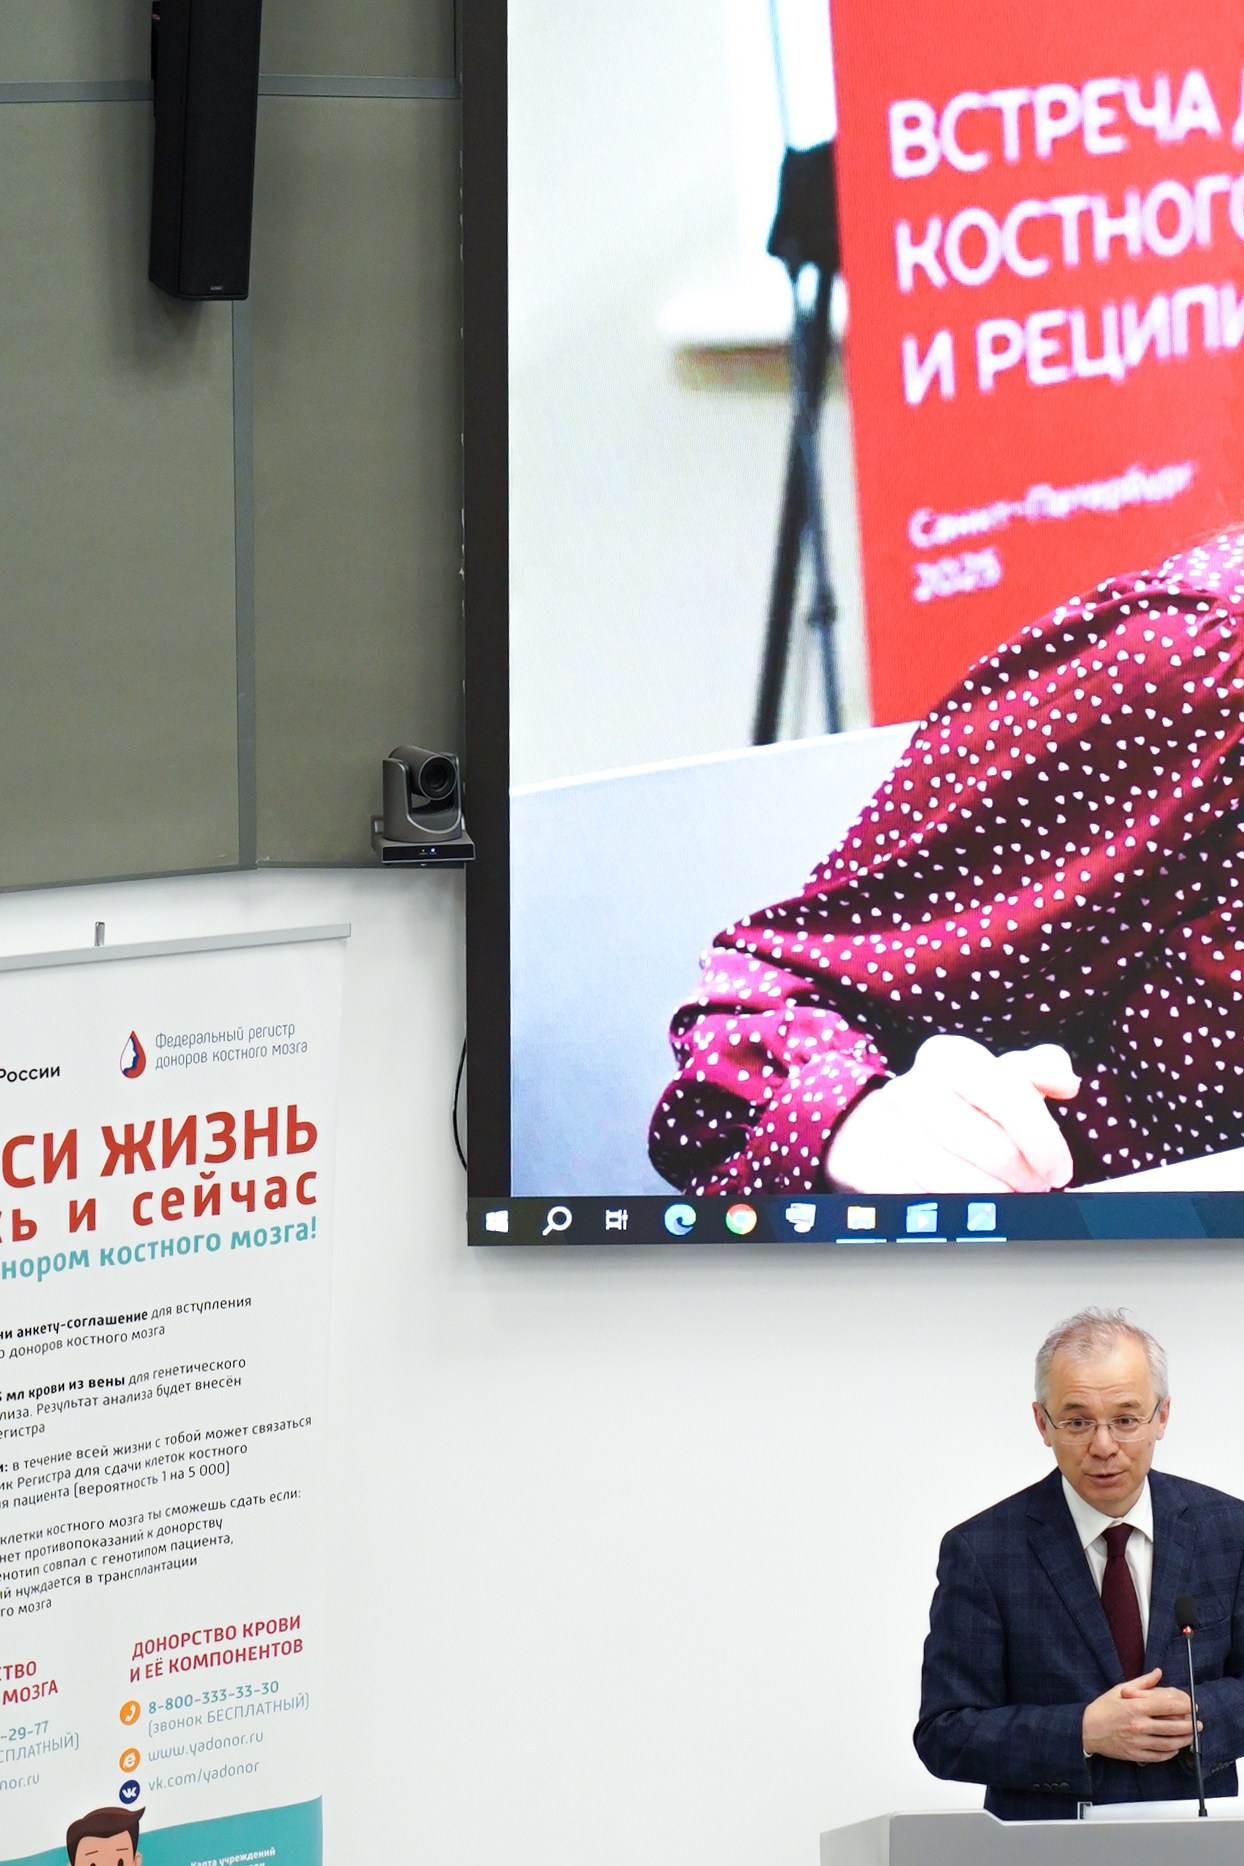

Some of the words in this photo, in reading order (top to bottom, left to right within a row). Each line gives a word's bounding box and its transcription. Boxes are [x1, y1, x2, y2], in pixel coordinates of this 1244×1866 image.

[888, 68, 1222, 179] ВСТРЕЧА
[902, 328, 955, 406] И
[155, 1026, 244, 1049] Федеральный
[249, 1023, 295, 1043] регистр
[155, 1052, 208, 1071] доноров
[212, 1046, 267, 1062] костного
[272, 1041, 308, 1056] мозга
[2, 1128, 77, 1188] СИ
[100, 1104, 318, 1177] ЖИЗНЬ
[69, 1198, 96, 1233] и
[133, 1170, 317, 1226] сейчас
[2, 1249, 90, 1282] нором
[100, 1233, 221, 1267] костного
[230, 1215, 317, 1249] мозга!
[17, 1310, 148, 1338] анкету-соглашение
[151, 1306, 172, 1320] для
[176, 1297, 252, 1315] вступления
[9, 1339, 63, 1359] доноров
[67, 1331, 128, 1347] костного
[131, 1325, 165, 1341] мозга
[6, 1390, 25, 1401] мл
[29, 1381, 65, 1399] крови
[69, 1380, 84, 1390] из
[88, 1375, 125, 1388] вены
[128, 1371, 149, 1385] для
[153, 1358, 246, 1380] генетического
[37, 1396, 98, 1415] Результат
[102, 1388, 153, 1406] анализа
[156, 1381, 192, 1398] будет
[195, 1375, 242, 1391] внесён
[12, 1461, 20, 1471] в
[24, 1450, 72, 1469] течение
[76, 1445, 109, 1459] всей
[112, 1441, 152, 1456] жизни
[155, 1438, 161, 1448] с
[164, 1430, 201, 1446] тобой
[205, 1426, 248, 1440] может
[252, 1416, 312, 1435] связаться
[13, 1486, 70, 1507] пациента
[74, 1474, 158, 1499] (вероятность
[162, 1470, 167, 1482] 1
[170, 1469, 184, 1480] на
[188, 1466, 196, 1478] 5
[200, 1460, 230, 1476] 000)
[17, 1468, 71, 1489] Регистра
[75, 1465, 100, 1479] для
[104, 1459, 142, 1476] сдачи
[145, 1452, 185, 1468] клеток
[189, 1443, 248, 1460] костного
[0, 1529, 43, 1545] клетки
[47, 1520, 105, 1536] костного
[109, 1514, 144, 1529] мозга
[148, 1510, 162, 1521] ты
[165, 1499, 226, 1517] сможешь
[230, 1494, 266, 1509] сдать
[269, 1489, 301, 1503] если:
[25, 1529, 144, 1560] противопоказаний
[147, 1529, 154, 1539] к
[156, 1518, 223, 1538] донорству
[43, 1557, 86, 1573] совпал
[91, 1556, 98, 1566] с
[102, 1544, 167, 1565] генотипом
[170, 1534, 234, 1551] пациента,
[16, 1575, 81, 1597] нуждается
[86, 1574, 93, 1584] в
[98, 1557, 198, 1585] трансплантации
[18, 1599, 52, 1615] мозга
[132, 1625, 237, 1661] ДОНОРСТВО
[242, 1615, 301, 1638] КРОВИ
[130, 1667, 140, 1683] И
[145, 1657, 163, 1679] ЕЁ
[169, 1638, 303, 1674] КОМПОНЕНТОВ
[2, 1679, 58, 1705] МОЗГА
[148, 1680, 279, 1714] 8-800-333-33-30
[148, 1714, 202, 1738] (звонок
[207, 1692, 310, 1724] БЕСПЛАТНЫЙ)
[148, 1732, 264, 1762] www.yadonor.ru
[148, 1762, 260, 1792] vk.com/yadonor
[219, 1846, 276, 1866] учреждений
